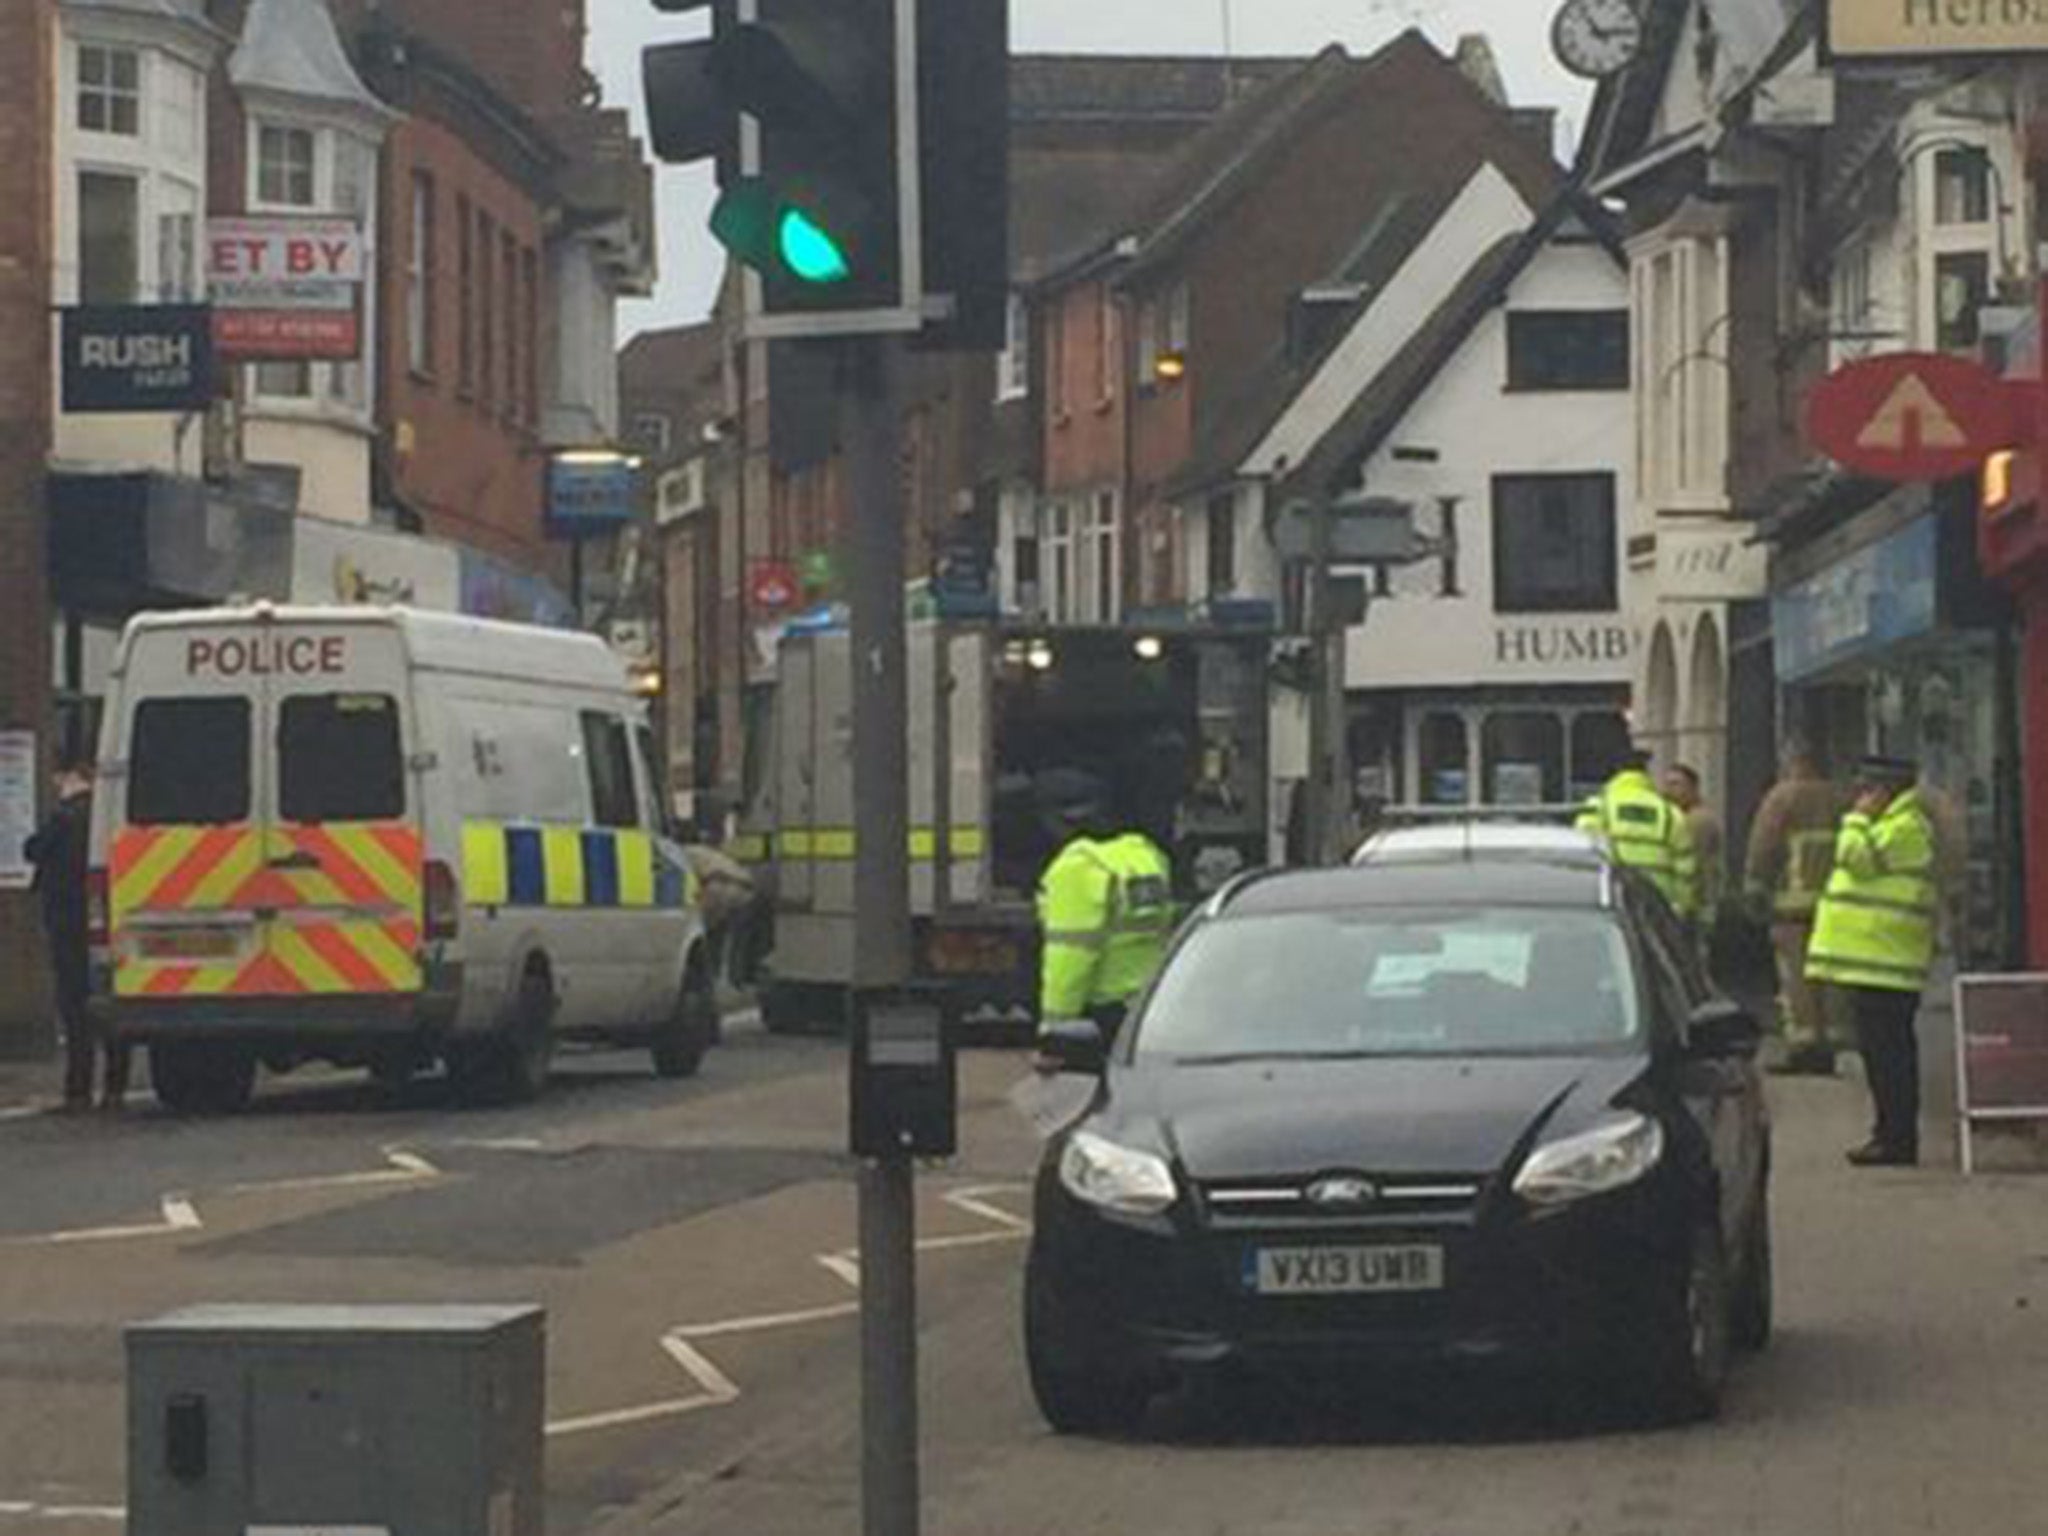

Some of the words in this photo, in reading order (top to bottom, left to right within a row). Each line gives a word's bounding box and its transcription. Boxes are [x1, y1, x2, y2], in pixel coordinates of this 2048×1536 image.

[287, 238, 348, 274] BY
[80, 333, 192, 368] RUSH
[186, 634, 346, 676] POLICE
